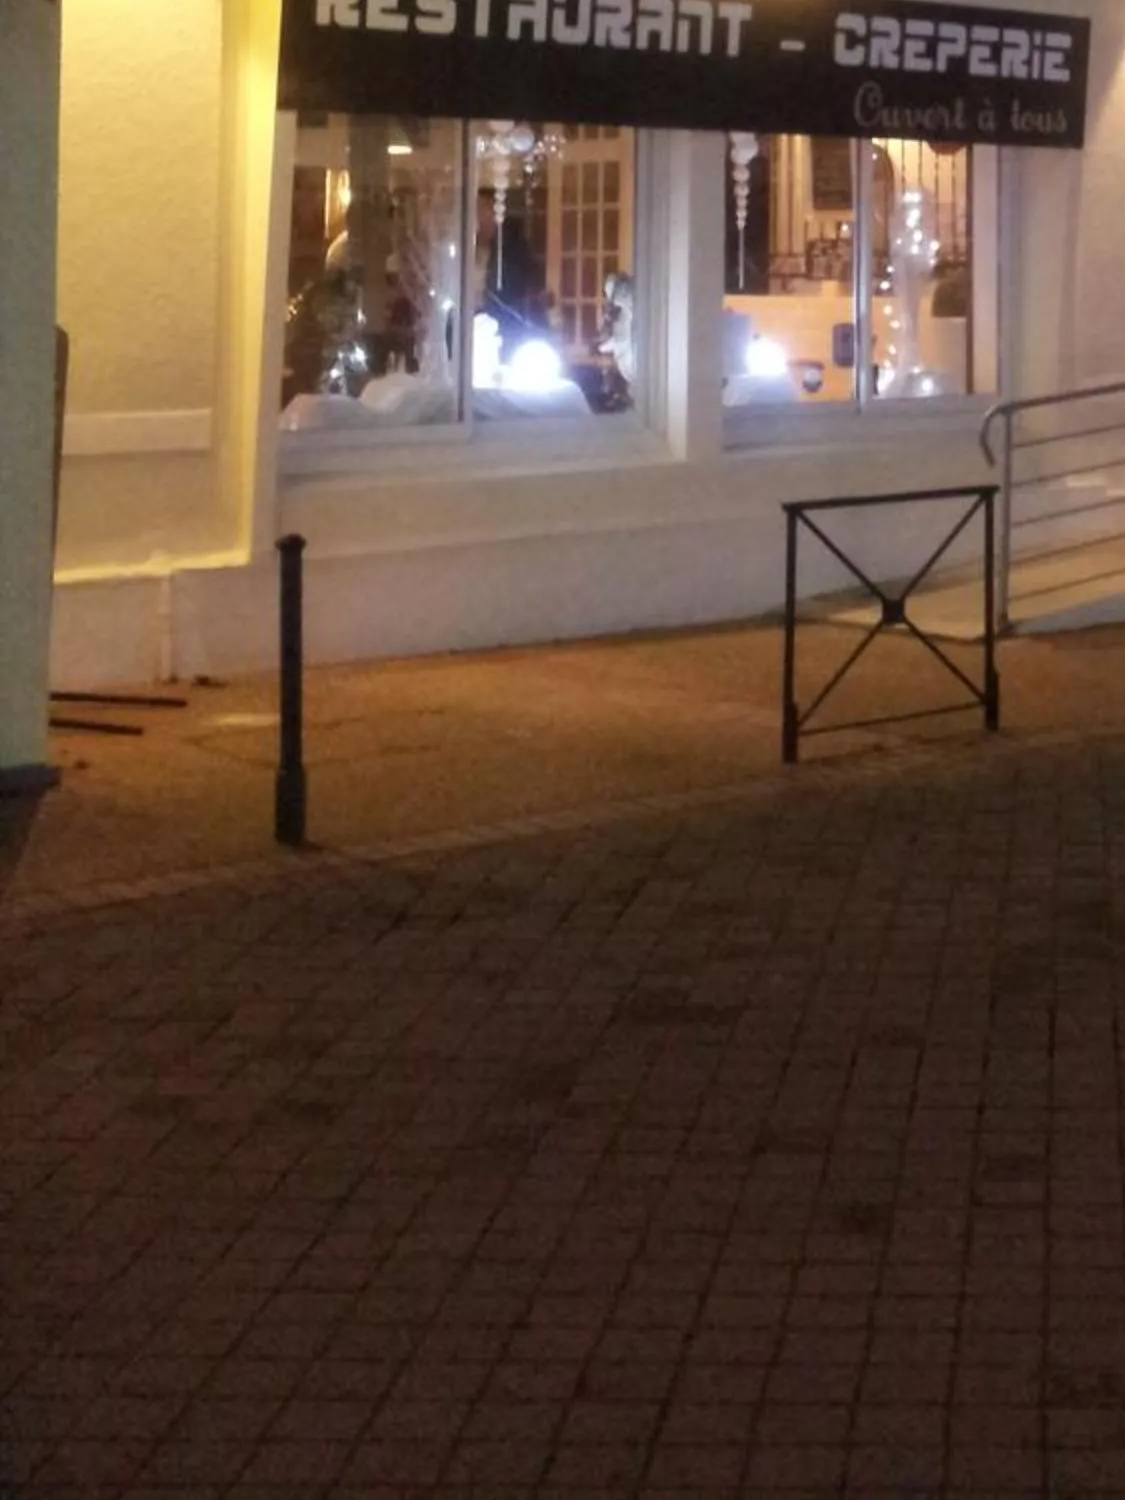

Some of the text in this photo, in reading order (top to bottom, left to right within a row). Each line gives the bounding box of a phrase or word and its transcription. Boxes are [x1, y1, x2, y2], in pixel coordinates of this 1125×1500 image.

[833, 12, 1072, 82] CREPERIE
[853, 80, 1068, 134] Ouvert à tous
